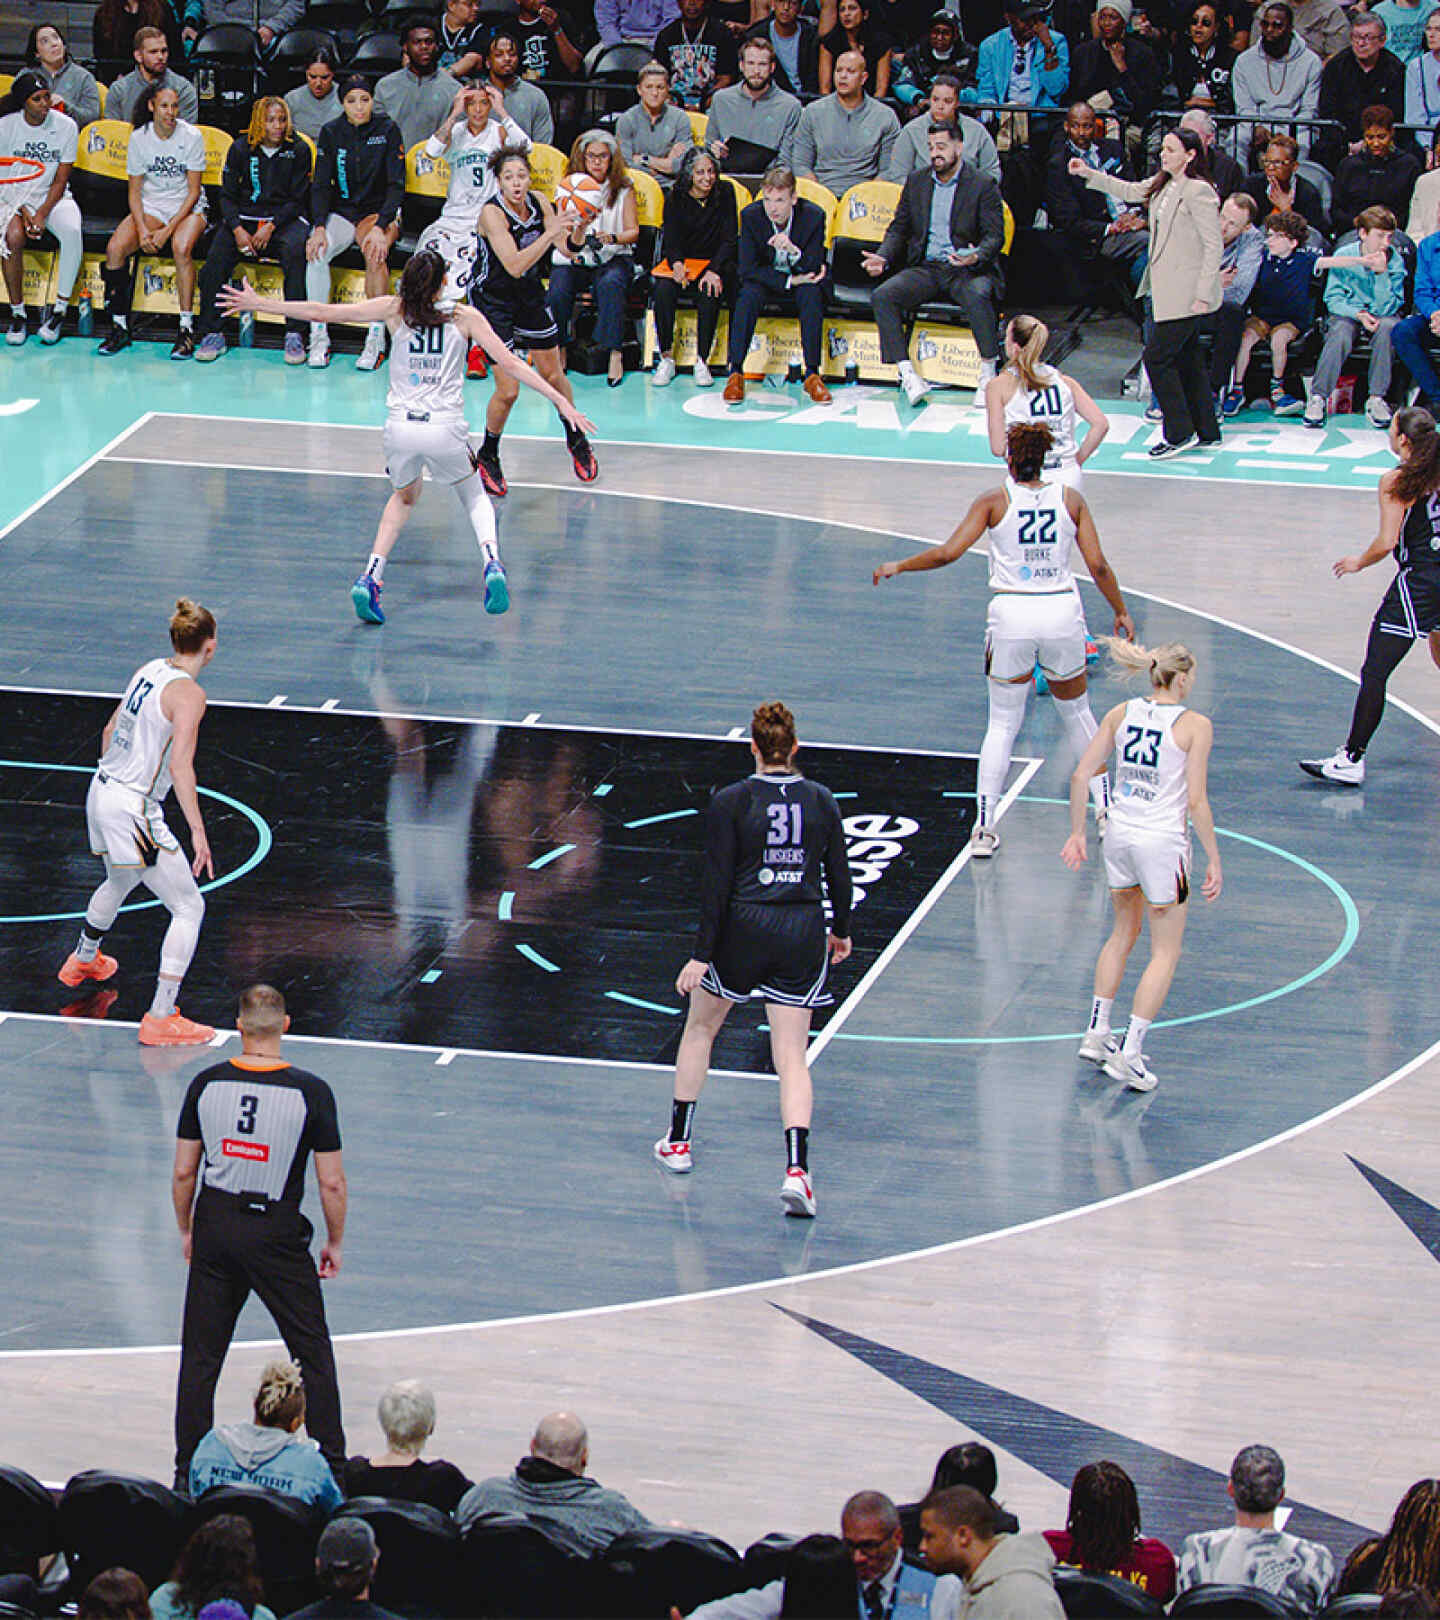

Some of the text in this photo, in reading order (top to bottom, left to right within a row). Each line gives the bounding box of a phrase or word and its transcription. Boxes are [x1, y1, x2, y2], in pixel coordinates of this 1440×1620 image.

[154, 156, 178, 166] NO
[472, 166, 485, 188] 9
[408, 325, 445, 354] 30
[1029, 384, 1063, 417] 20
[1018, 508, 1057, 545] 22
[125, 676, 154, 716] 13
[1122, 724, 1163, 768] 23
[766, 802, 803, 846] 31
[775, 870, 804, 883] AT&T
[236, 1095, 259, 1135] 3
